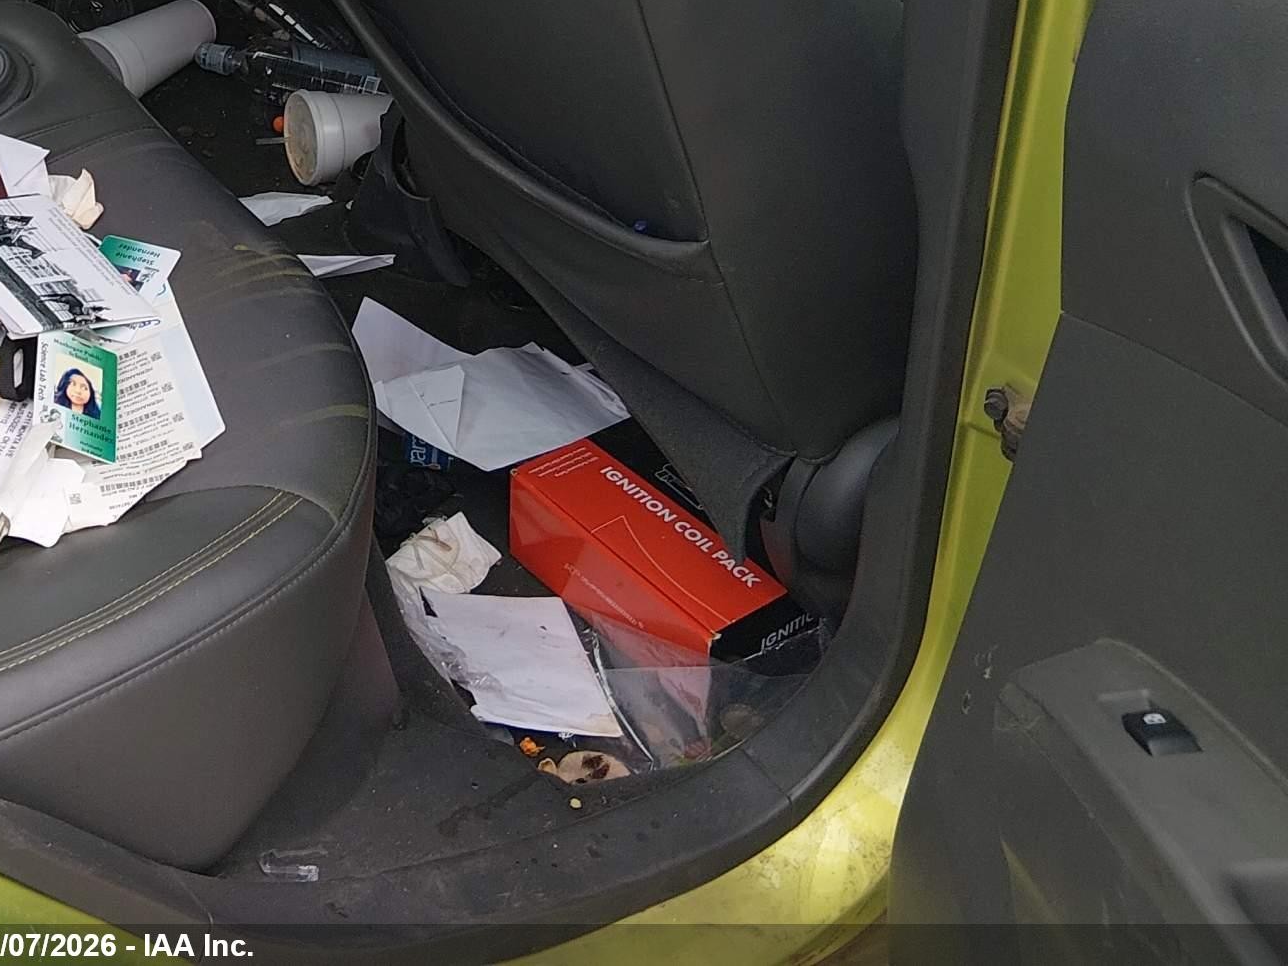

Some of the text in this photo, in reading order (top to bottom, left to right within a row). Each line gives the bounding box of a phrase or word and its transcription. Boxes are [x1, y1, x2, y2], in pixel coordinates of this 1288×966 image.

[115, 251, 156, 266] Stephanie
[38, 341, 49, 402] Science Lab Tech
[69, 422, 114, 444] Hernandez
[72, 414, 112, 434] Stephanie
[599, 465, 762, 588] IGNITION COIL PACK
